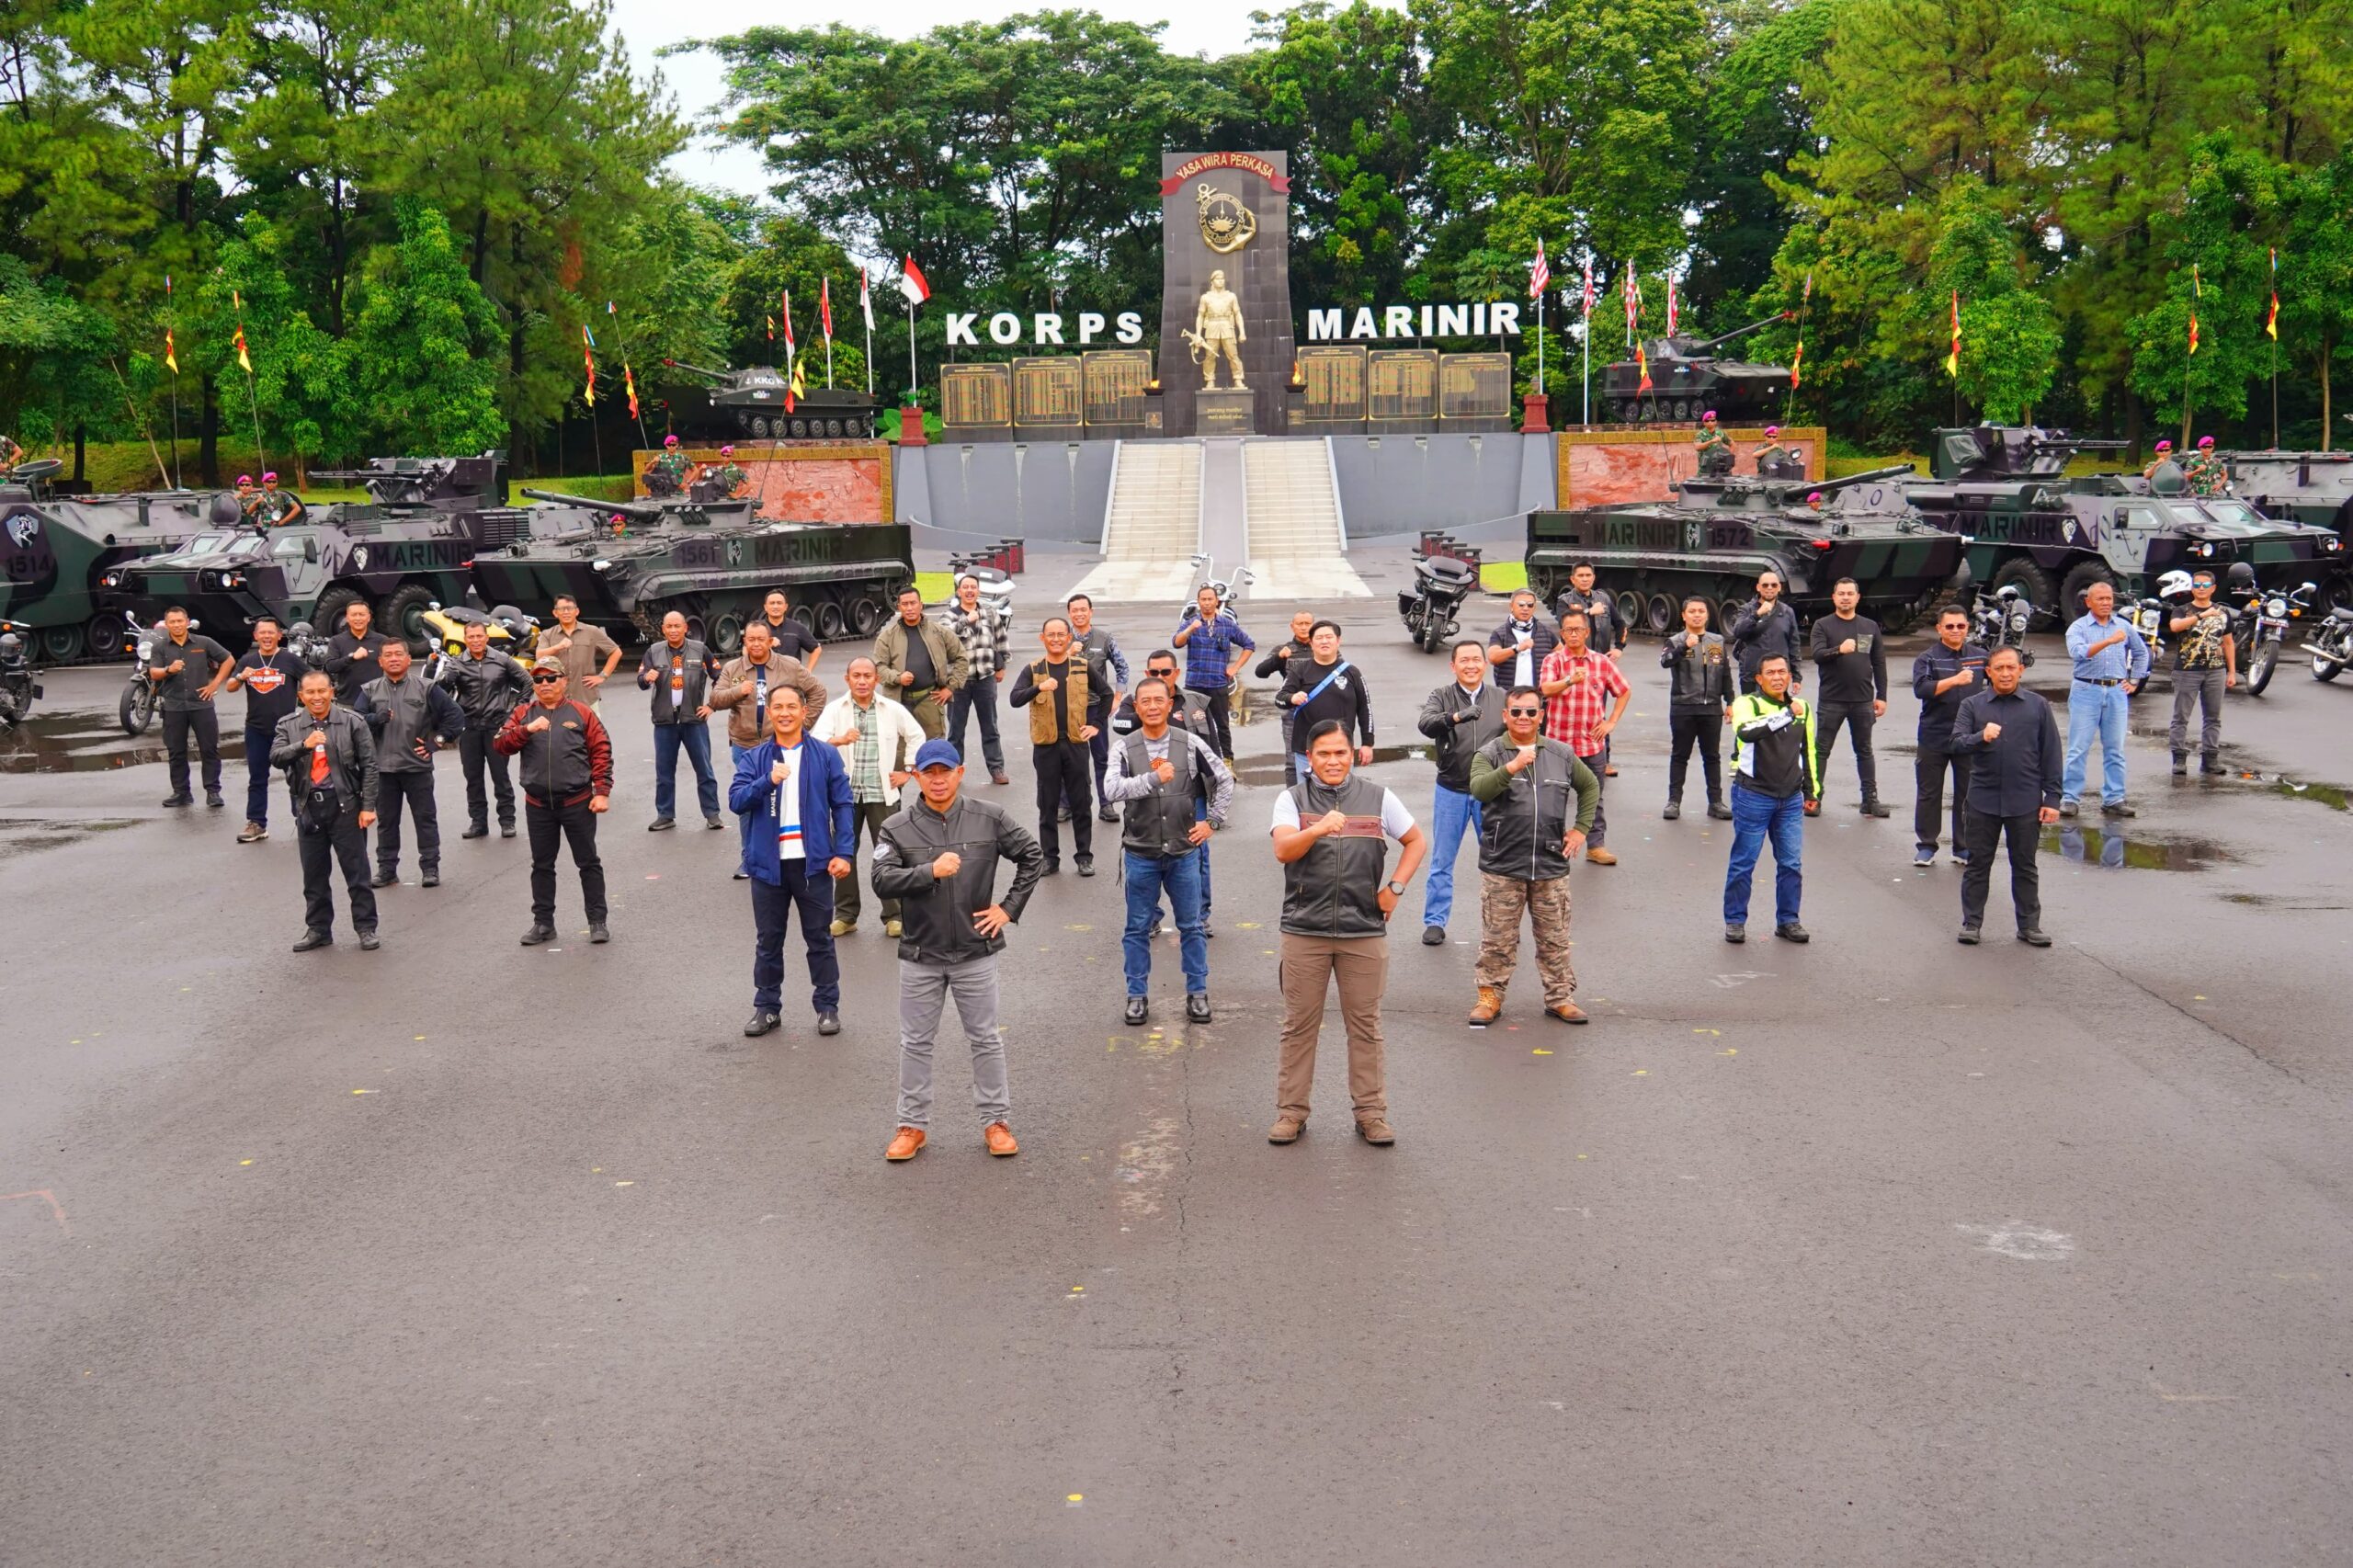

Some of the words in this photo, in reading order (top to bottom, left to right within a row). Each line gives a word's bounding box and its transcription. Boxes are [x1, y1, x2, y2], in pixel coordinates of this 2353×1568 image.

[1176, 160, 1202, 180] YASA
[1200, 153, 1228, 169] WIRA
[1230, 154, 1274, 179] PERKASA
[946, 312, 1142, 345] KORPS
[1308, 301, 1521, 340] MARINIR
[1594, 523, 1677, 546] MARINIR
[1711, 528, 1749, 547] 1572
[1961, 514, 2056, 540] MARINIR
[373, 542, 471, 568] MARINIR
[681, 545, 716, 564] 1561
[755, 537, 843, 563] MARINIR
[7, 554, 50, 574] 1514
